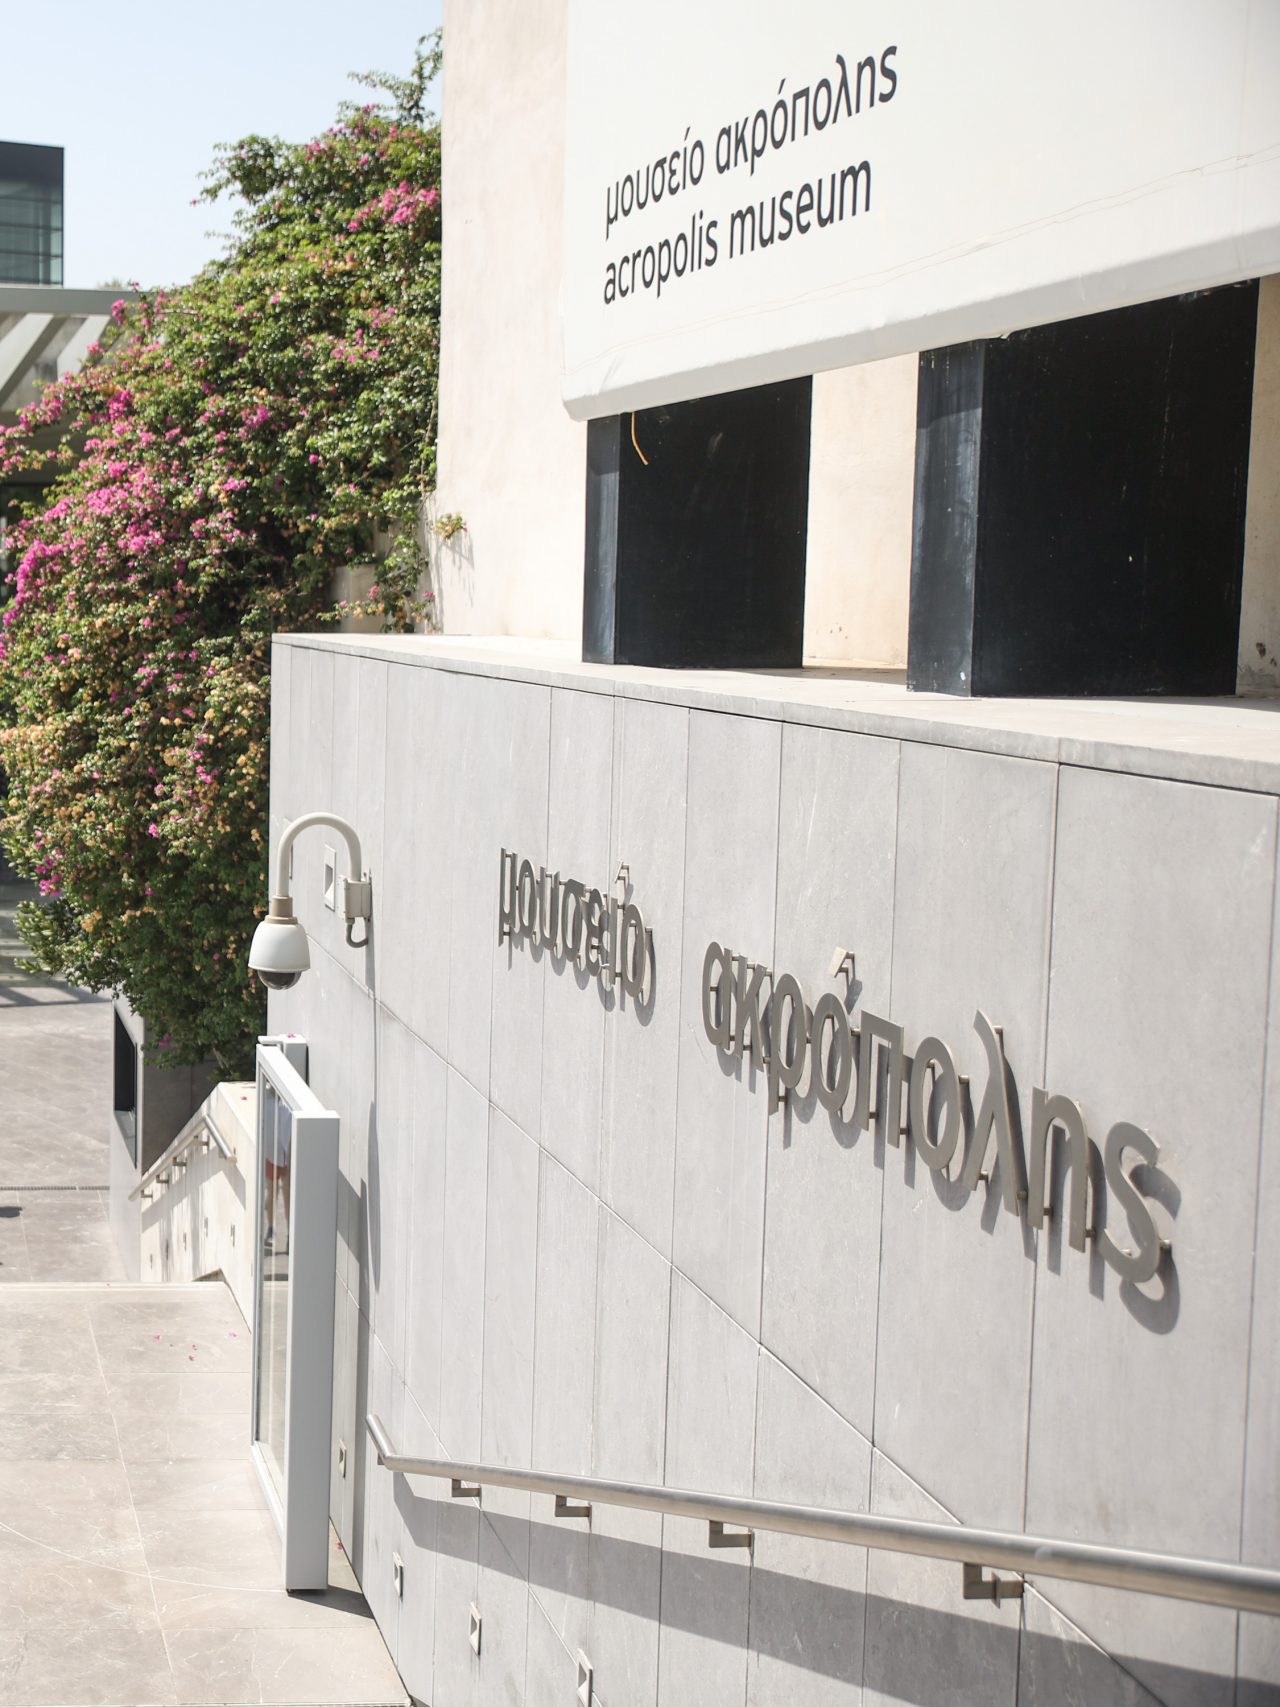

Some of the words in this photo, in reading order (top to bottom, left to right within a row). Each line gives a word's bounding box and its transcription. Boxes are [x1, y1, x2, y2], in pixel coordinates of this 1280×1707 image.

[603, 210, 718, 306] acropolis
[729, 160, 871, 260] museum
[605, 126, 705, 241] μουσείο
[714, 45, 898, 176] ακρόπολης
[497, 846, 646, 999] μουσείο
[701, 940, 1162, 1284] ακρόπολης
